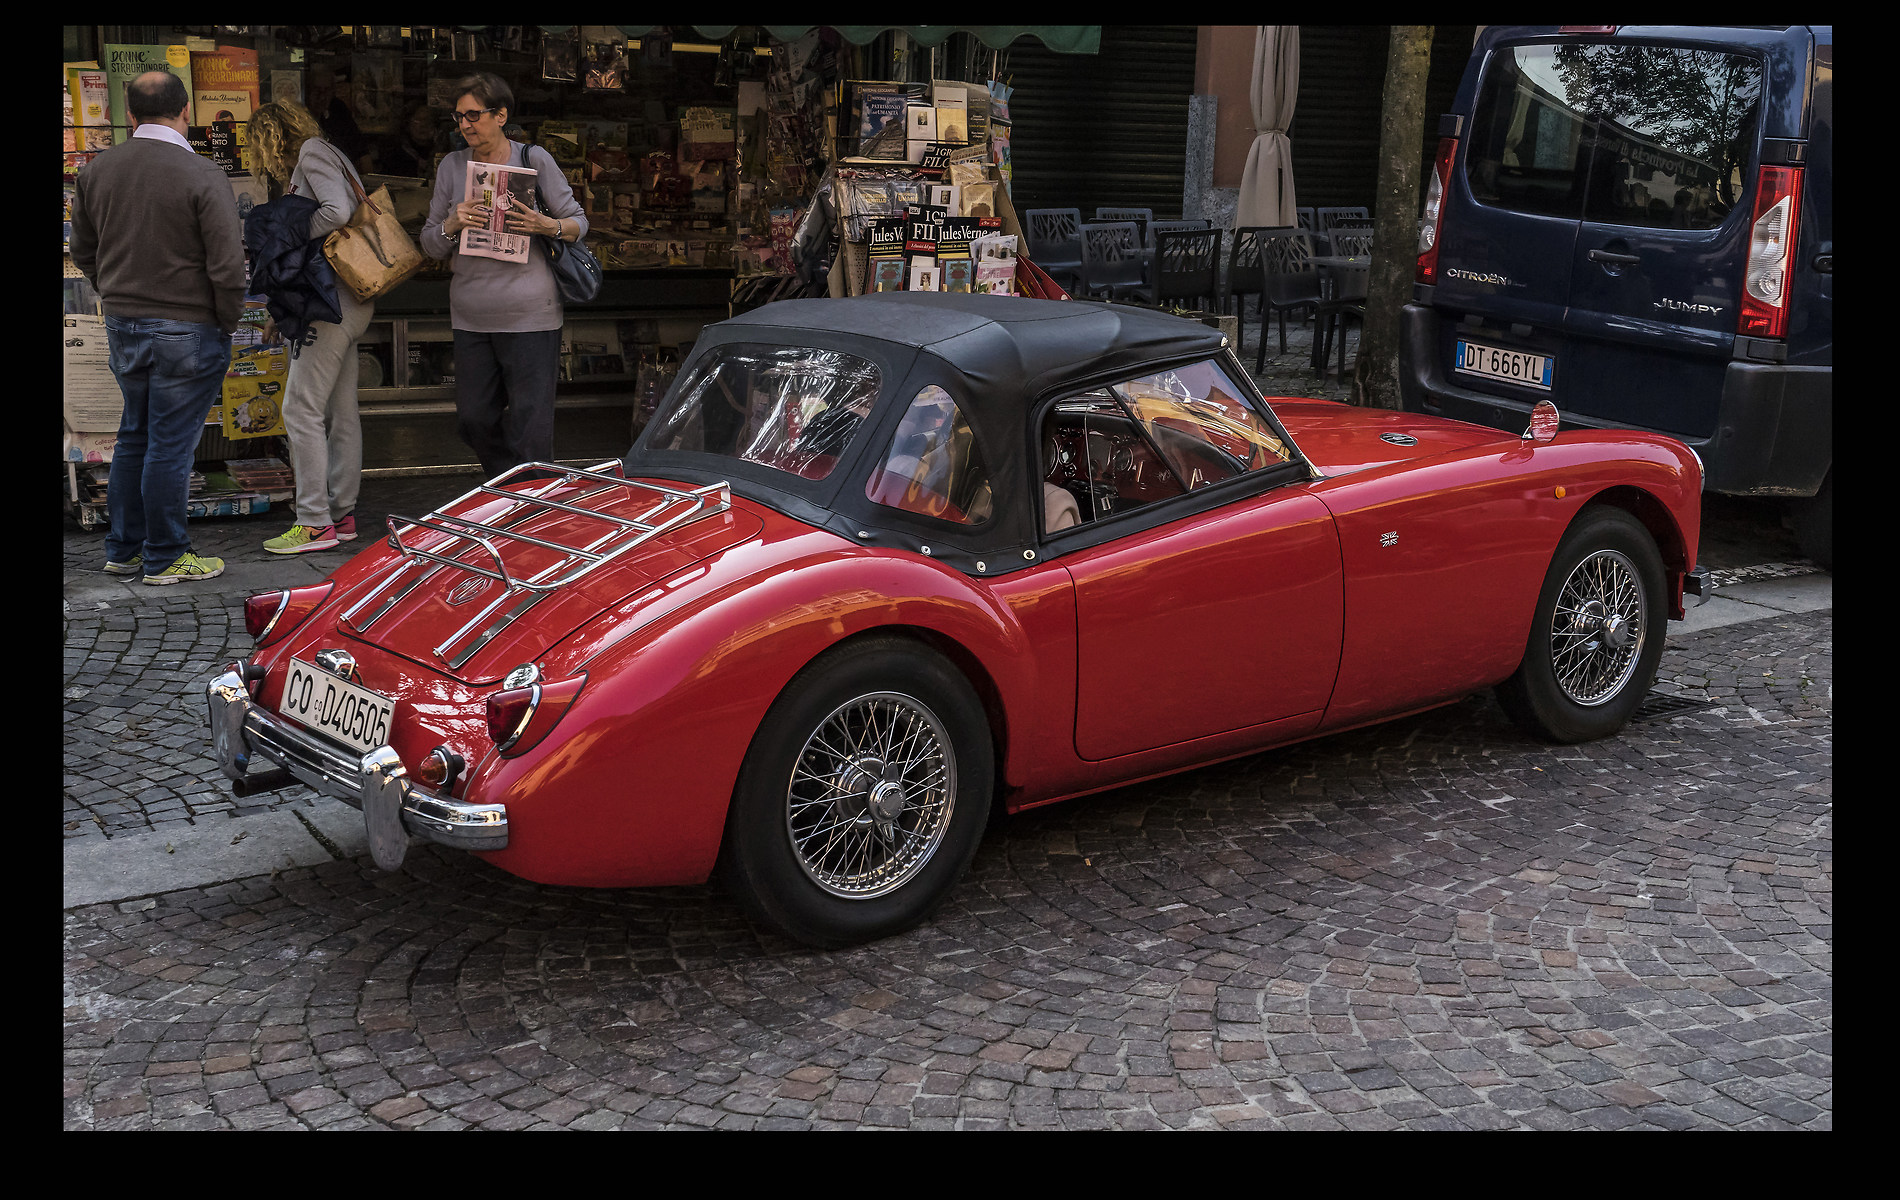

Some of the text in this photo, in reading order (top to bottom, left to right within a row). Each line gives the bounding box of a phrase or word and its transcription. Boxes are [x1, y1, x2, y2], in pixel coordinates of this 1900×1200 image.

[111, 50, 149, 64] DONNE
[193, 57, 233, 71] DONNE
[111, 62, 170, 75] STRAORDINARIE
[194, 69, 259, 85] STRAORDINARIE
[869, 227, 893, 246] Jules
[912, 223, 935, 241] FIL
[938, 225, 988, 244] Jules Verne
[1447, 267, 1508, 286] CITROËN
[1653, 297, 1724, 317] JUMPY
[1466, 344, 1541, 381] DT 666YL
[287, 668, 391, 748] CO D40505
